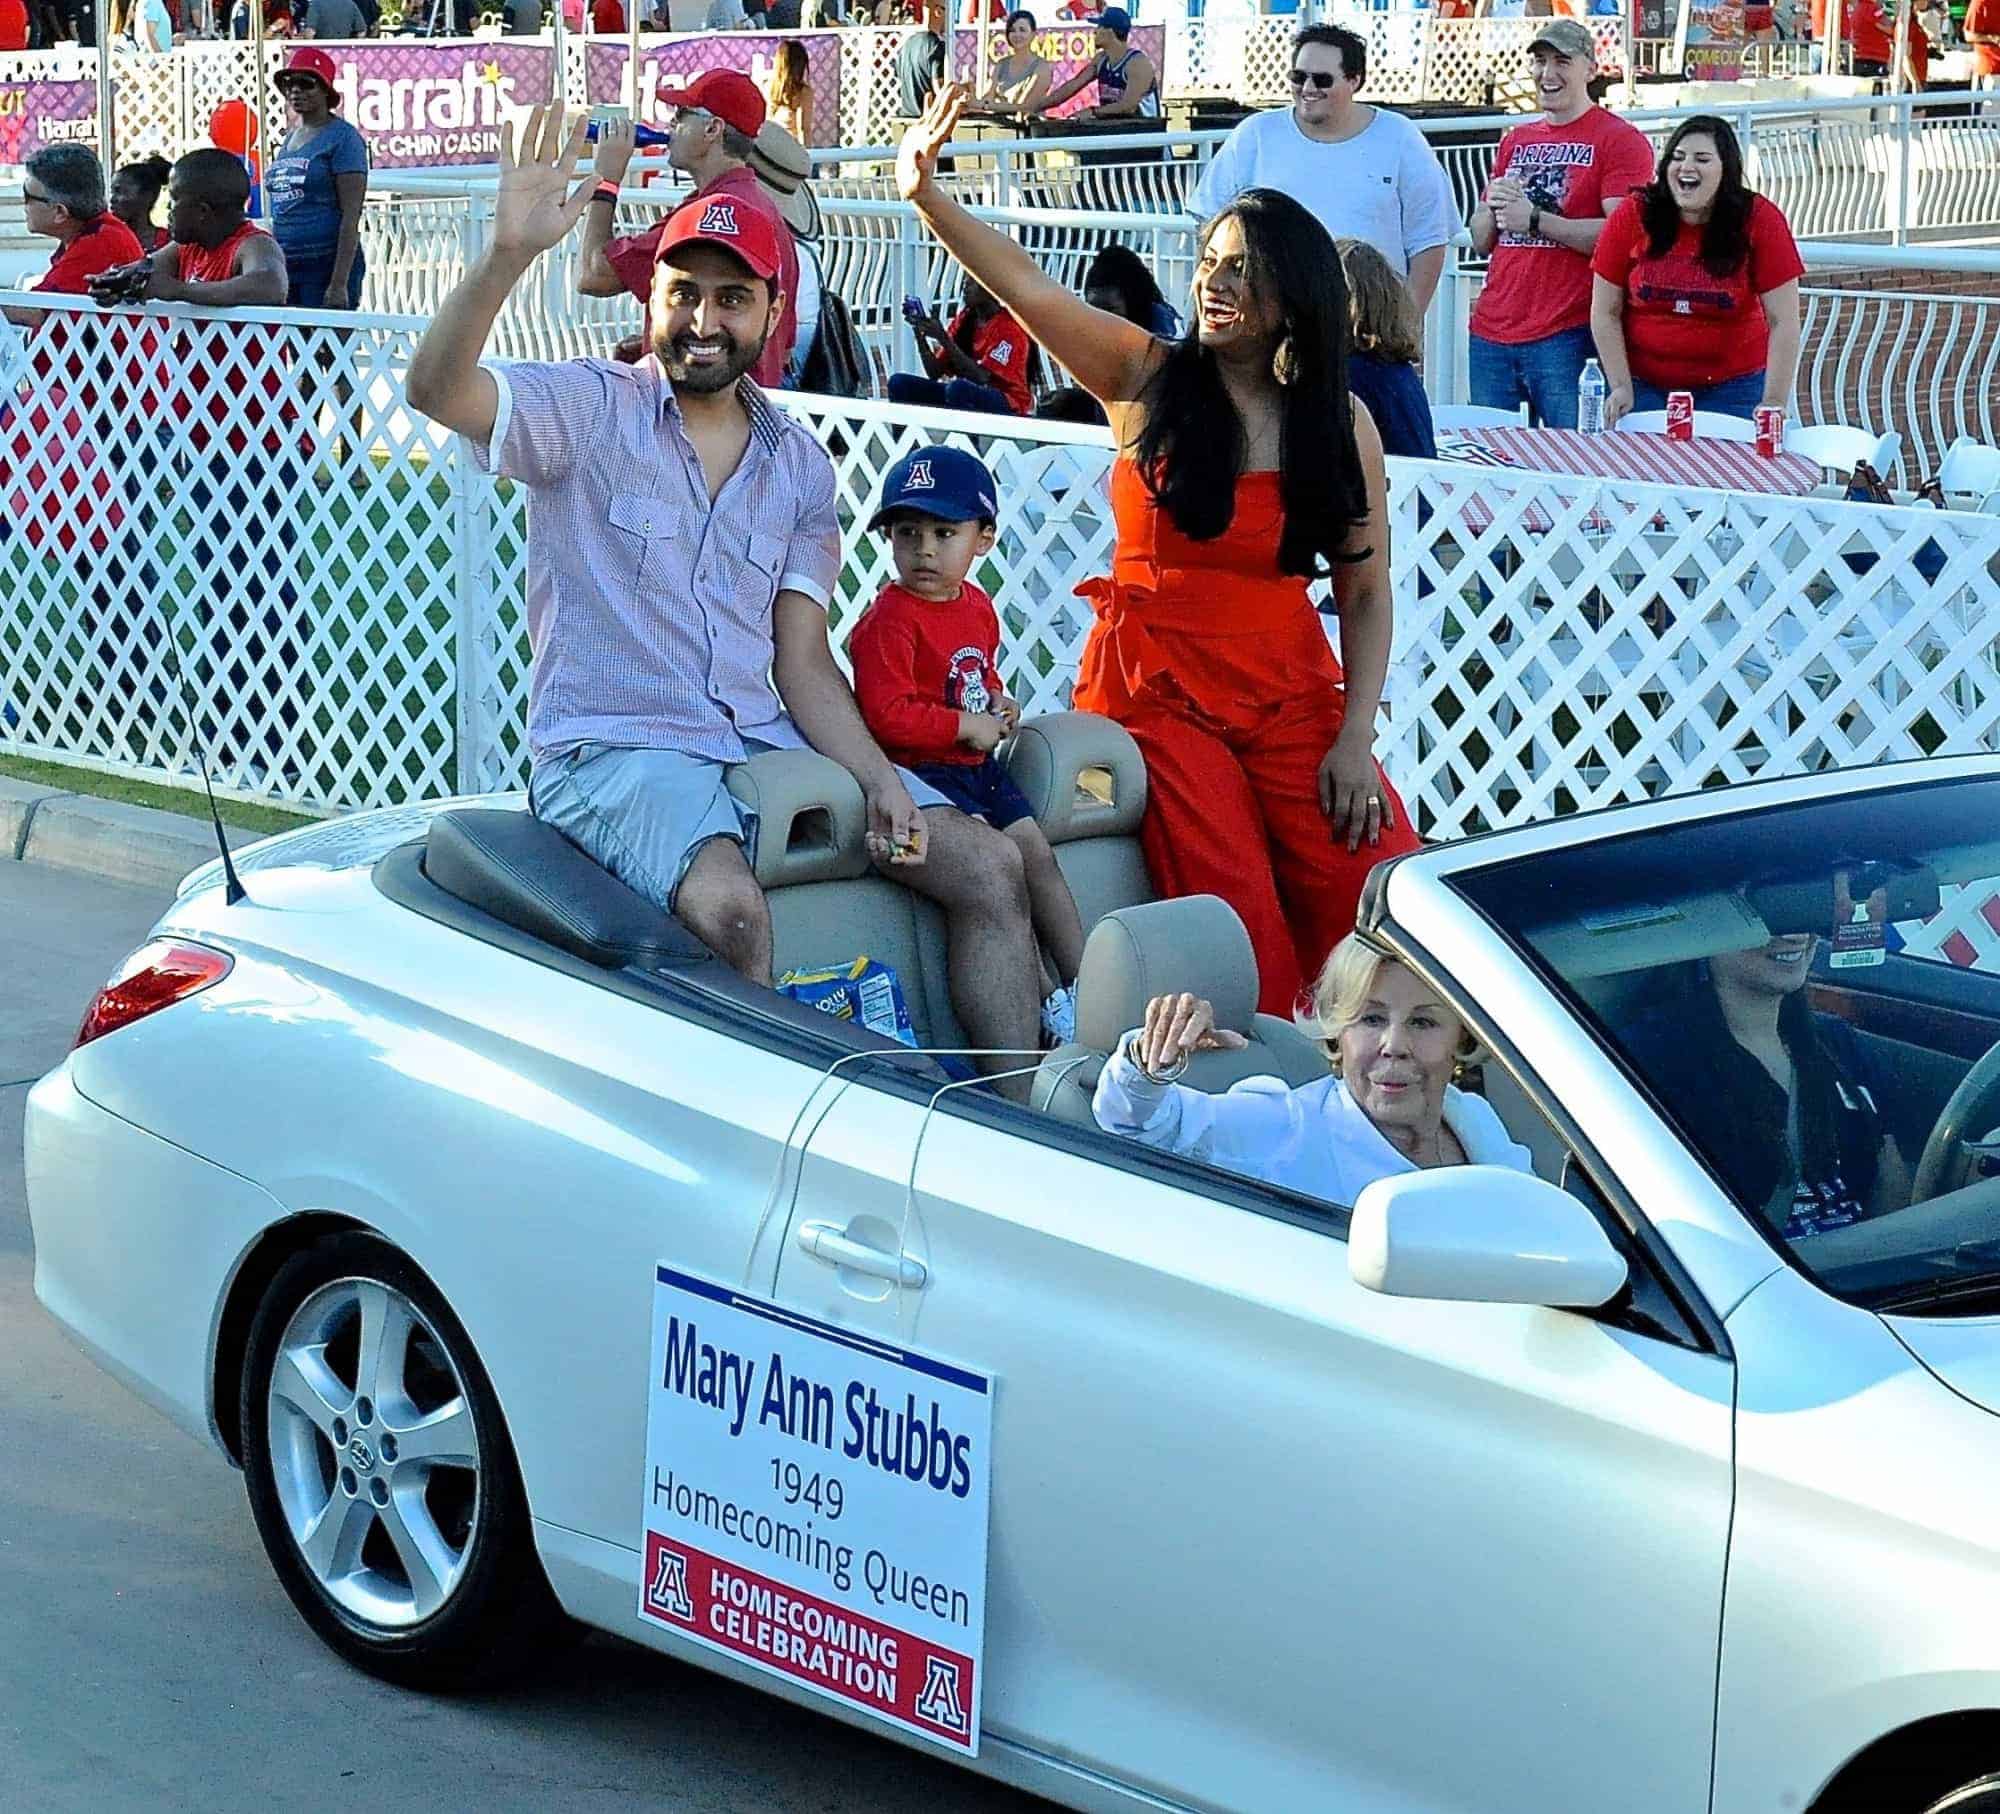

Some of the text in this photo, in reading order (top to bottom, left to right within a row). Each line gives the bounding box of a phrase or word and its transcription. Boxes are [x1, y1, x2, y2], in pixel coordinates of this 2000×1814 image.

[988, 33, 1065, 62] CME
[368, 132, 501, 156] K-CHIN CASIN
[1511, 142, 1594, 166] ARIZONA
[697, 203, 739, 235] A
[904, 460, 935, 489] A
[663, 1316, 971, 1498] Mary Ann Stubbs
[770, 1458, 844, 1520] 1949
[653, 1465, 969, 1627] Homecoming Queen
[649, 1547, 694, 1622] A
[710, 1568, 898, 1669] HOMECOMING
[710, 1604, 896, 1704] CELEBRATION
[915, 1655, 966, 1733] A
